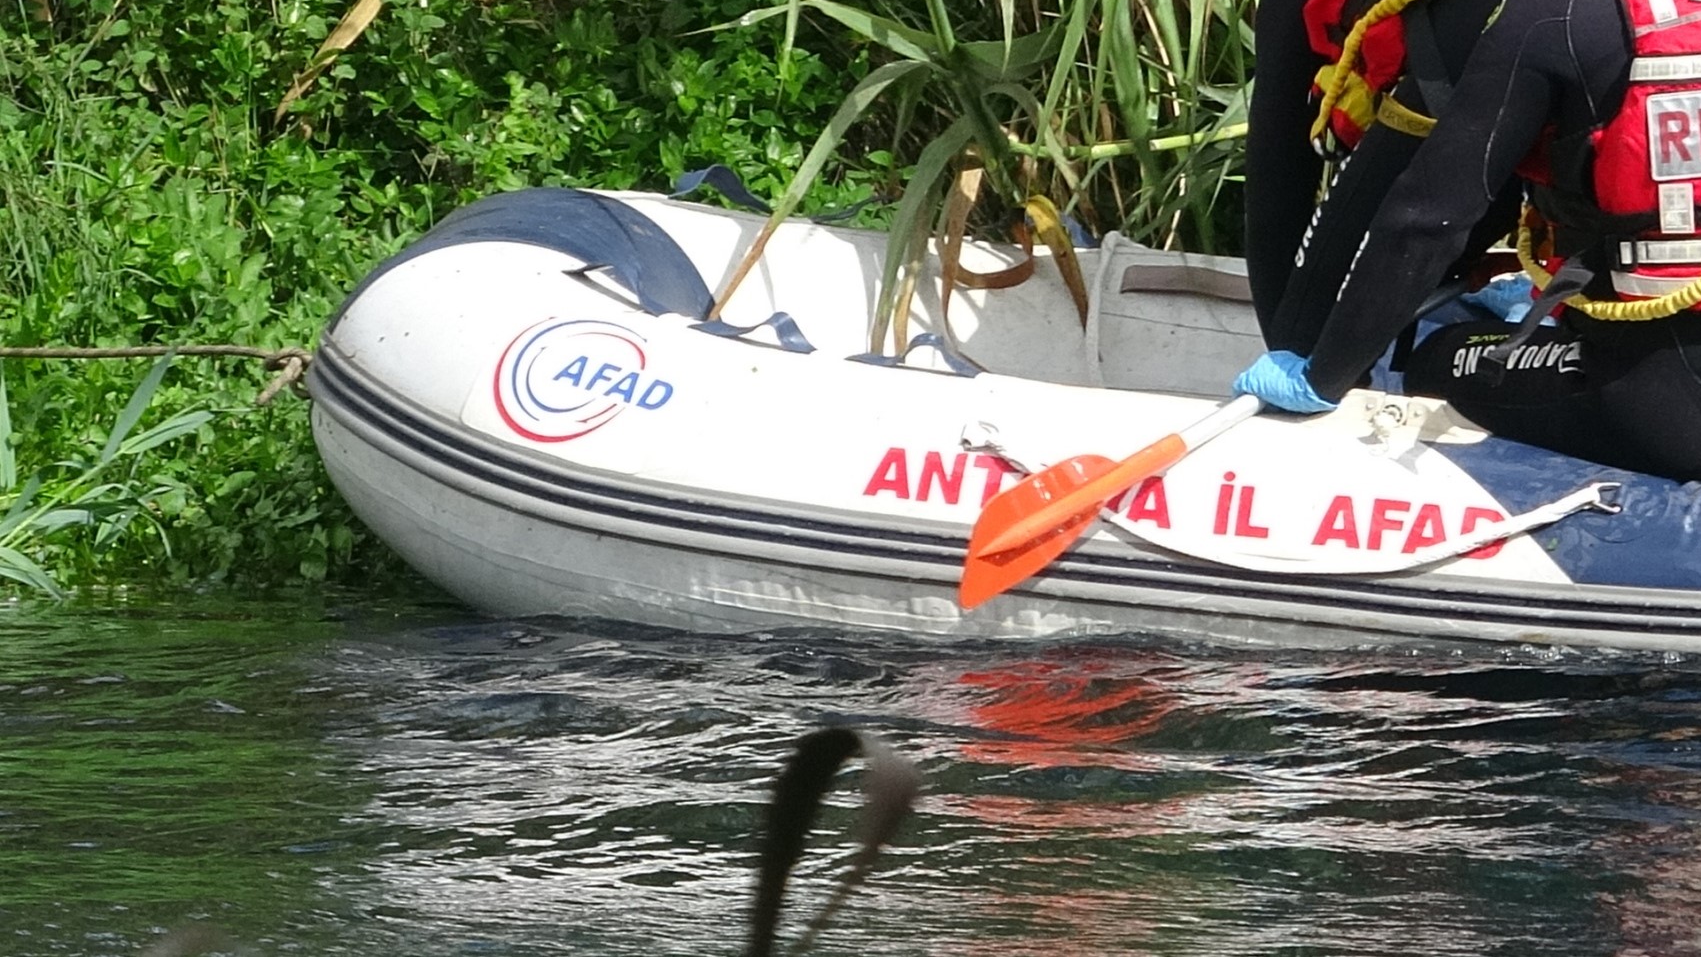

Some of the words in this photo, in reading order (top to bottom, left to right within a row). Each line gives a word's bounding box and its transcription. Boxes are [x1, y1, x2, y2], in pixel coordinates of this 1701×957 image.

[553, 355, 674, 411] AFAD
[1452, 340, 1568, 378] AQUANG
[863, 447, 1171, 530] ANTA
[1213, 471, 1270, 539] İL
[1310, 495, 1506, 560] AFAD
